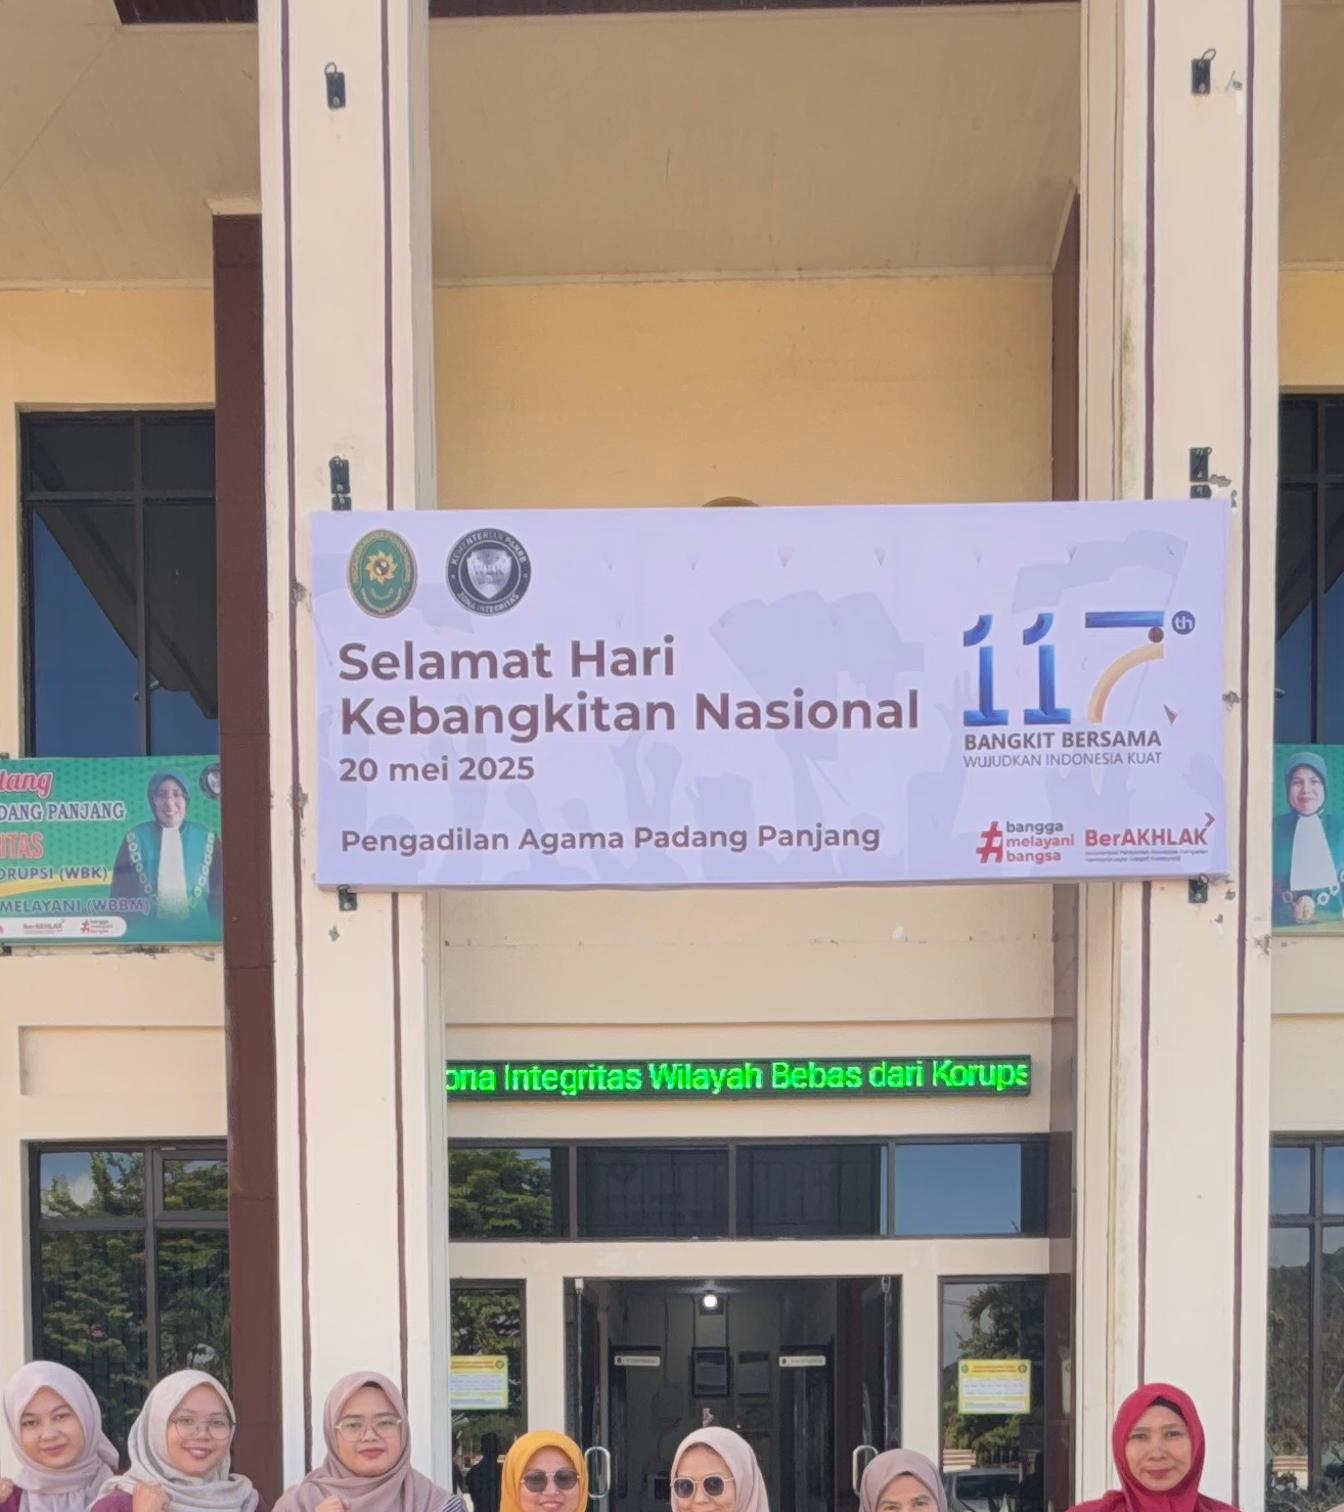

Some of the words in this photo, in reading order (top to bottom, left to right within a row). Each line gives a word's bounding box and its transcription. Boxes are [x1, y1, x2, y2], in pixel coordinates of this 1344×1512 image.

[1174, 615, 1194, 630] th
[338, 640, 554, 681] Selamat
[570, 634, 674, 678] Hari
[962, 611, 1165, 727] 117
[340, 690, 676, 744] Kebangkitan
[695, 687, 919, 730] Nasional
[964, 732, 1056, 751] BANGKIT
[1061, 730, 1163, 748] BERSAMA
[338, 757, 379, 782] 20
[388, 755, 449, 782] mei
[458, 756, 536, 781] 2025
[962, 754, 1043, 768] WUJUDKAN
[1045, 752, 1123, 767] INDONESIA
[1127, 751, 1163, 765] KUAT
[47, 801, 126, 820] PANJANG
[1006, 821, 1064, 835] bangga
[341, 826, 510, 857] Pengadilan
[518, 828, 625, 856] Agama
[634, 825, 748, 854] Padang
[757, 822, 881, 852] Panjang
[1006, 834, 1075, 850] melayani
[1084, 828, 1208, 848] BerAKHLAK
[1006, 850, 1062, 865] bangsa
[58, 865, 109, 882] (WBK)
[0, 899, 81, 913] MELAYANI
[86, 898, 152, 916] (WBBM)
[504, 1064, 643, 1096] Integritas
[648, 1062, 763, 1095] Wilayah
[771, 1061, 863, 1089] Bebas
[868, 1060, 925, 1088] dari
